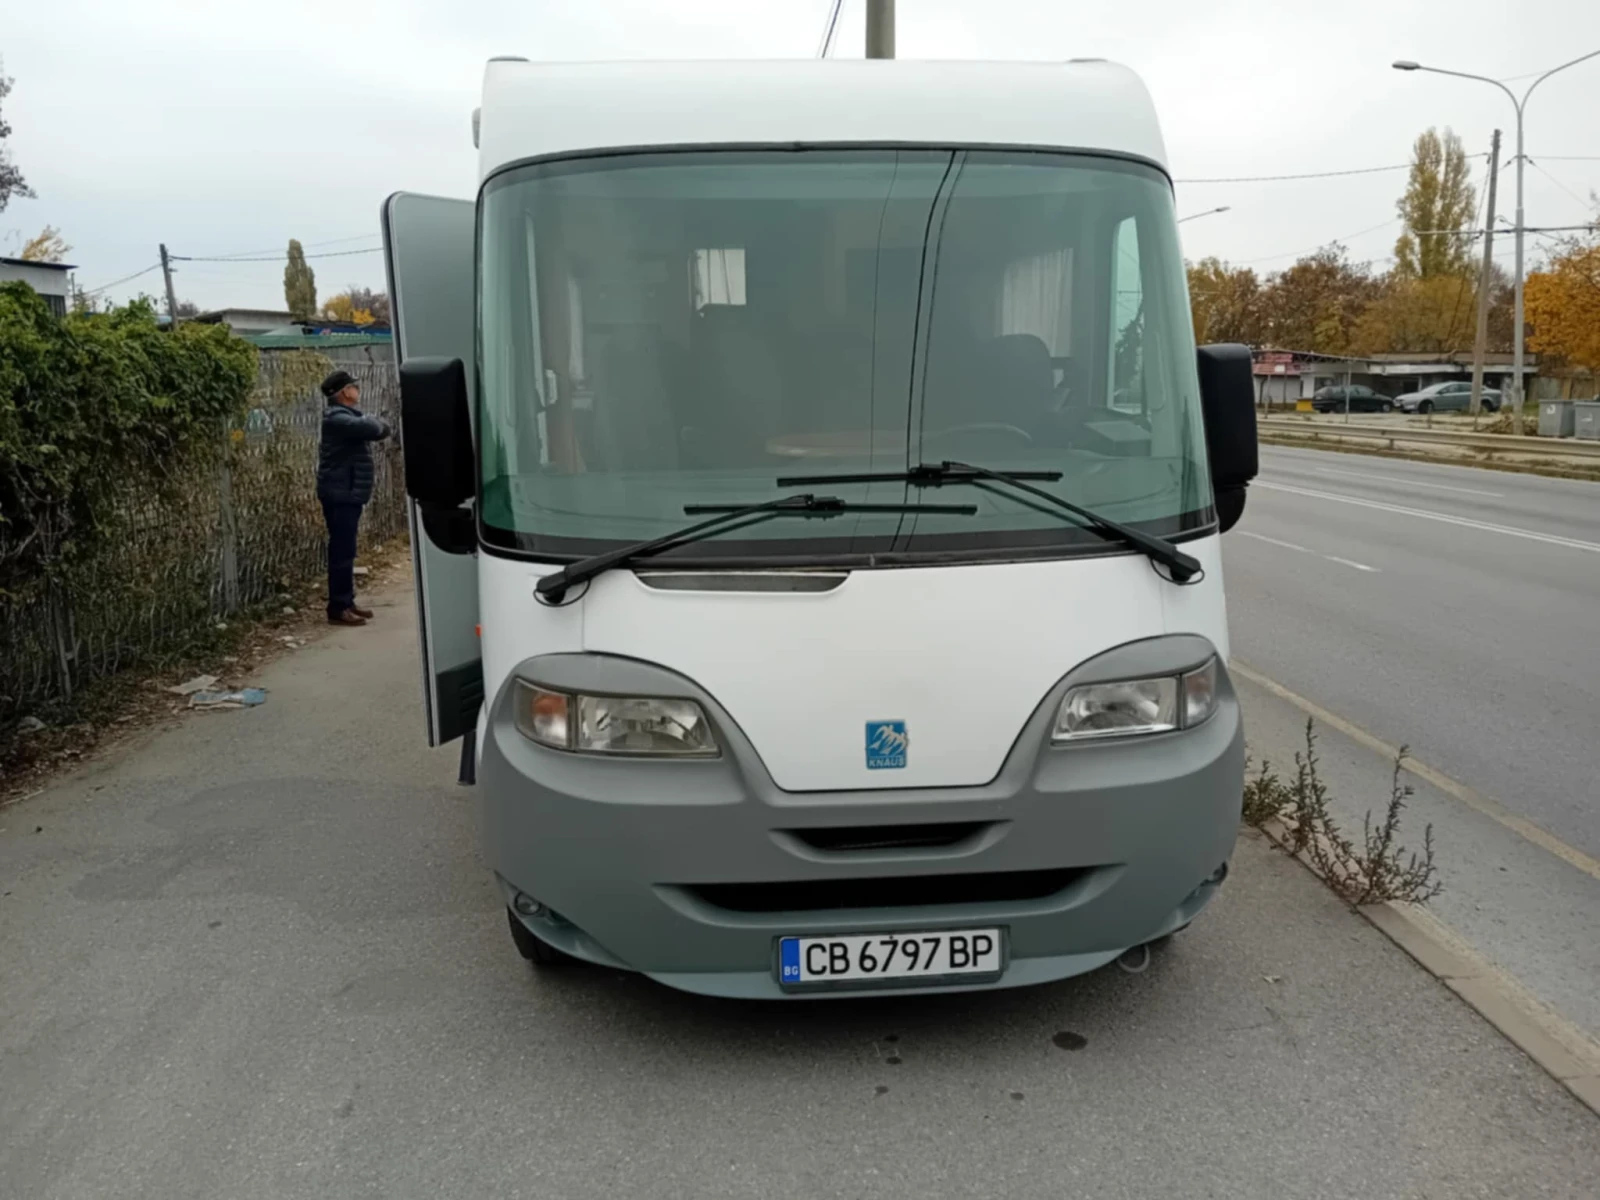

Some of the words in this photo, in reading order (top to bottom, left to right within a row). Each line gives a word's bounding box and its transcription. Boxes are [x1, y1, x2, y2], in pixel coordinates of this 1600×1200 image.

[806, 943, 850, 975] CB
[859, 937, 941, 972] 6797
[949, 935, 993, 968] BP
[784, 966, 799, 976] BG
